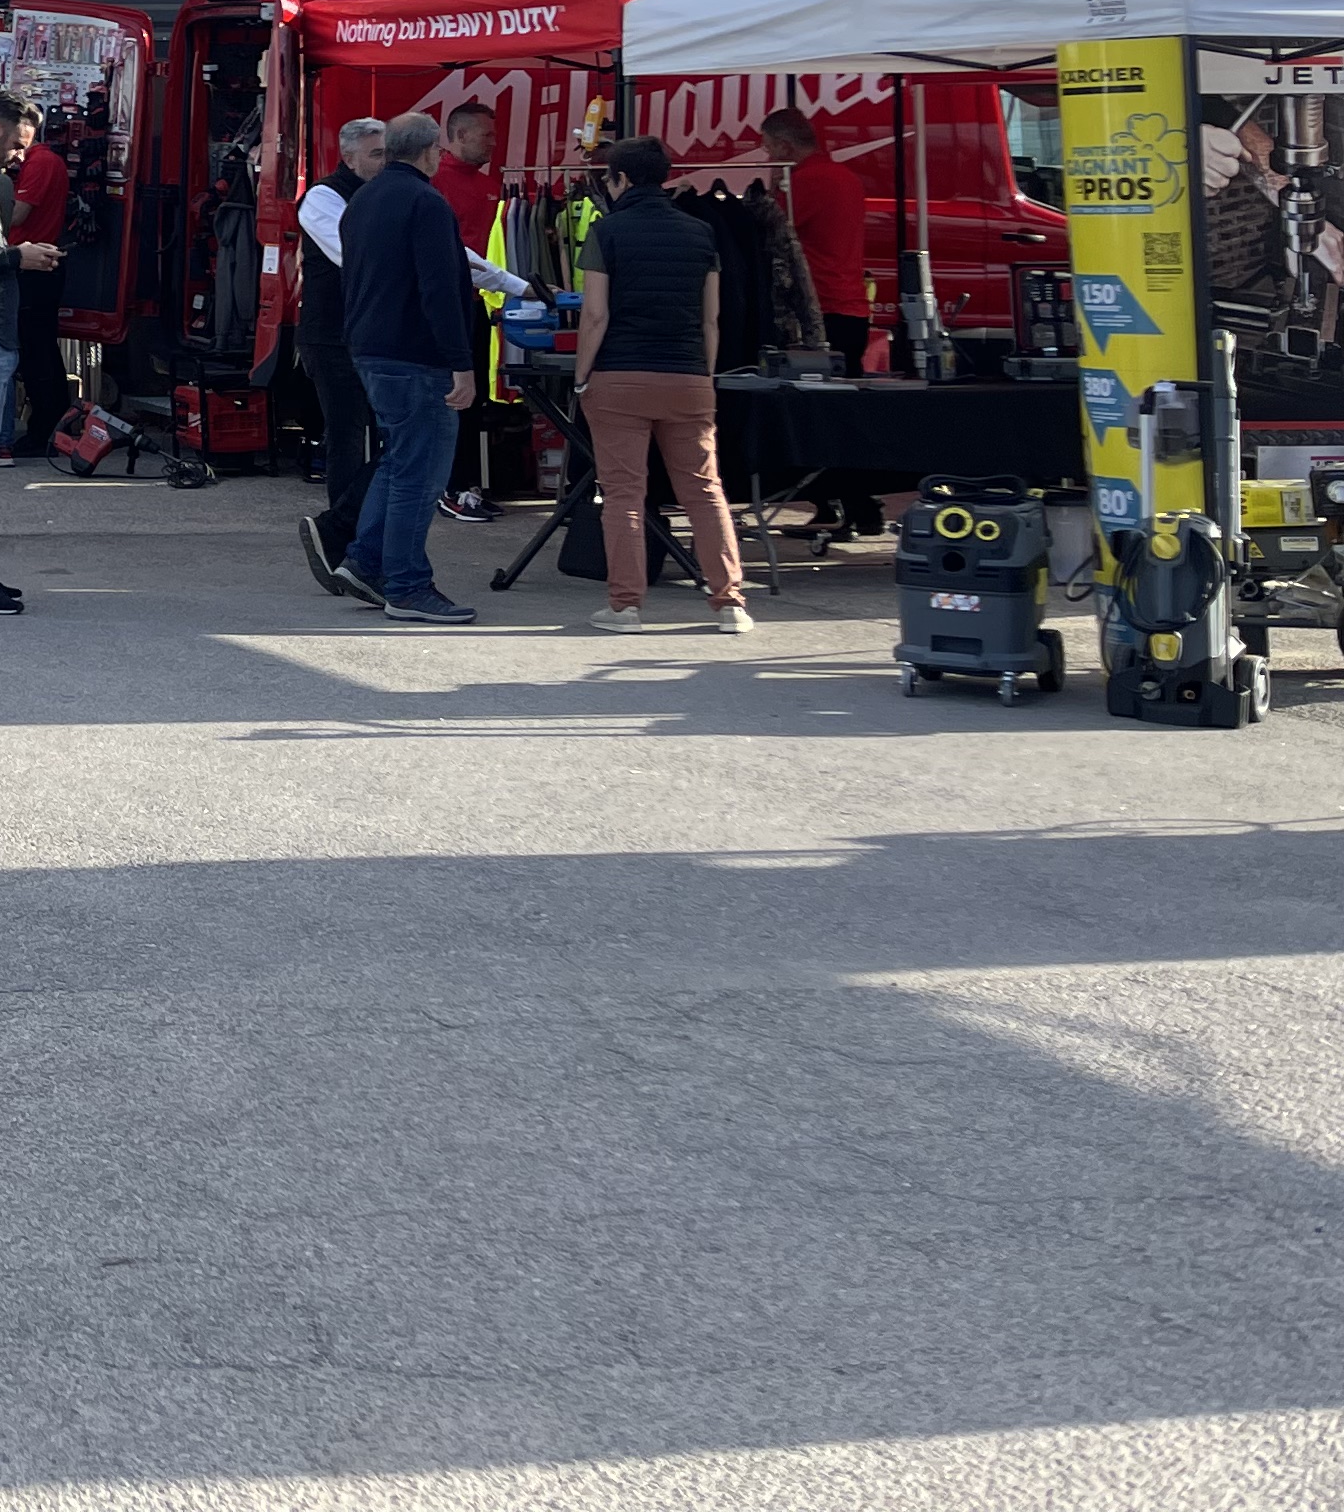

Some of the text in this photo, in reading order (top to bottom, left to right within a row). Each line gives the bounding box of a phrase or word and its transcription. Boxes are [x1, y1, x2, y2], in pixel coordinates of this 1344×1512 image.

[336, 19, 396, 47] Nothing
[399, 17, 426, 40] but
[429, 11, 494, 38] HEAVY
[1264, 66, 1343, 85] JET
[1083, 177, 1155, 201] PROS
